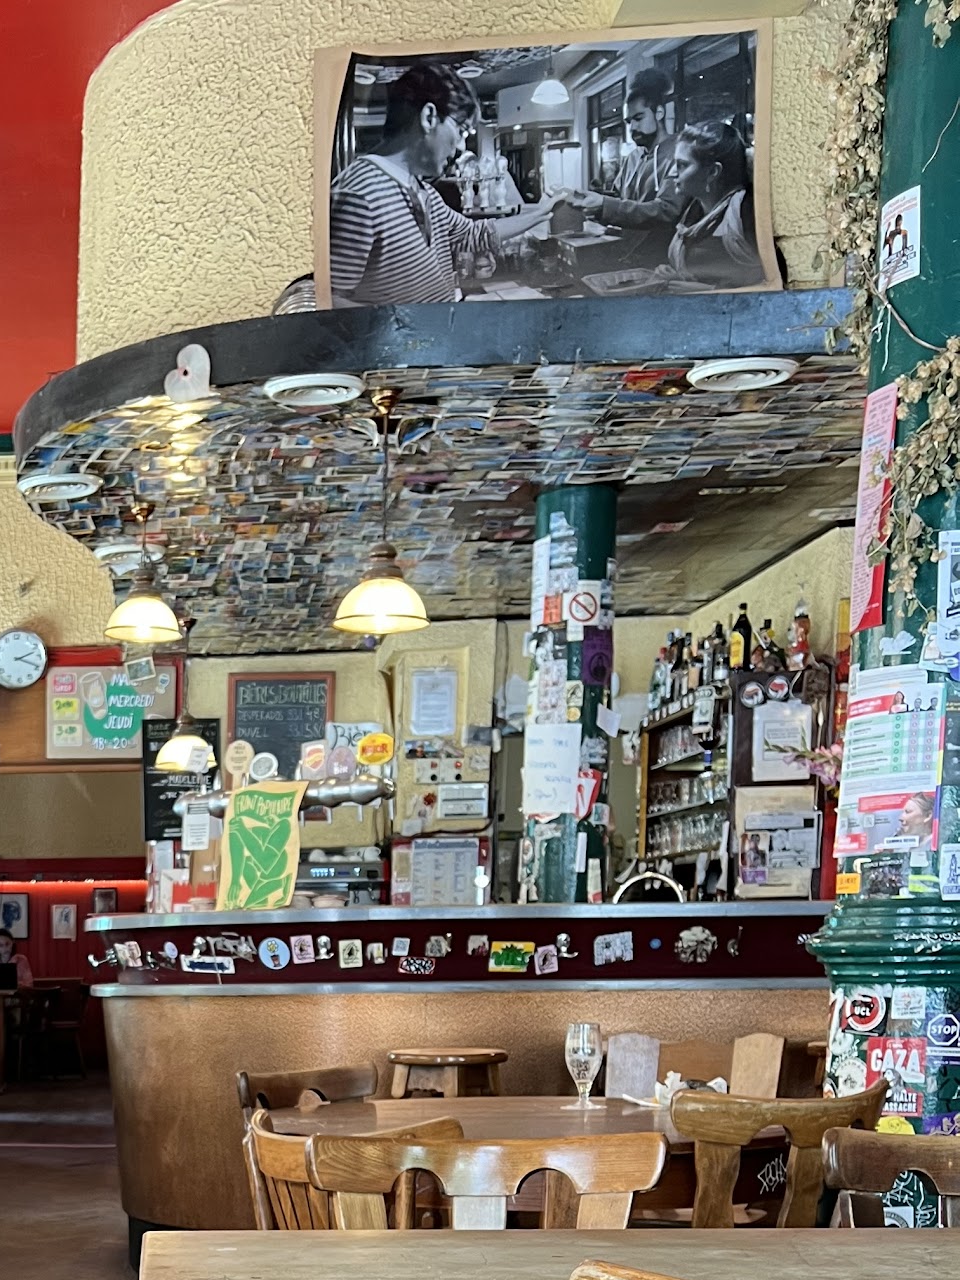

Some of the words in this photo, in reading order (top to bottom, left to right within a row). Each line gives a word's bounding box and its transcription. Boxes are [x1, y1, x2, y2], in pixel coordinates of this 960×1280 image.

[109, 693, 155, 708] MERCREDI
[103, 713, 134, 730] JEUDI
[238, 727, 269, 738] DUVEL
[853, 1006, 872, 1017] UCL
[930, 1024, 958, 1035] STOP
[870, 1048, 922, 1074] GAZA
[893, 1092, 917, 1103] HALTE
[883, 1102, 917, 1113] ASSACRE
